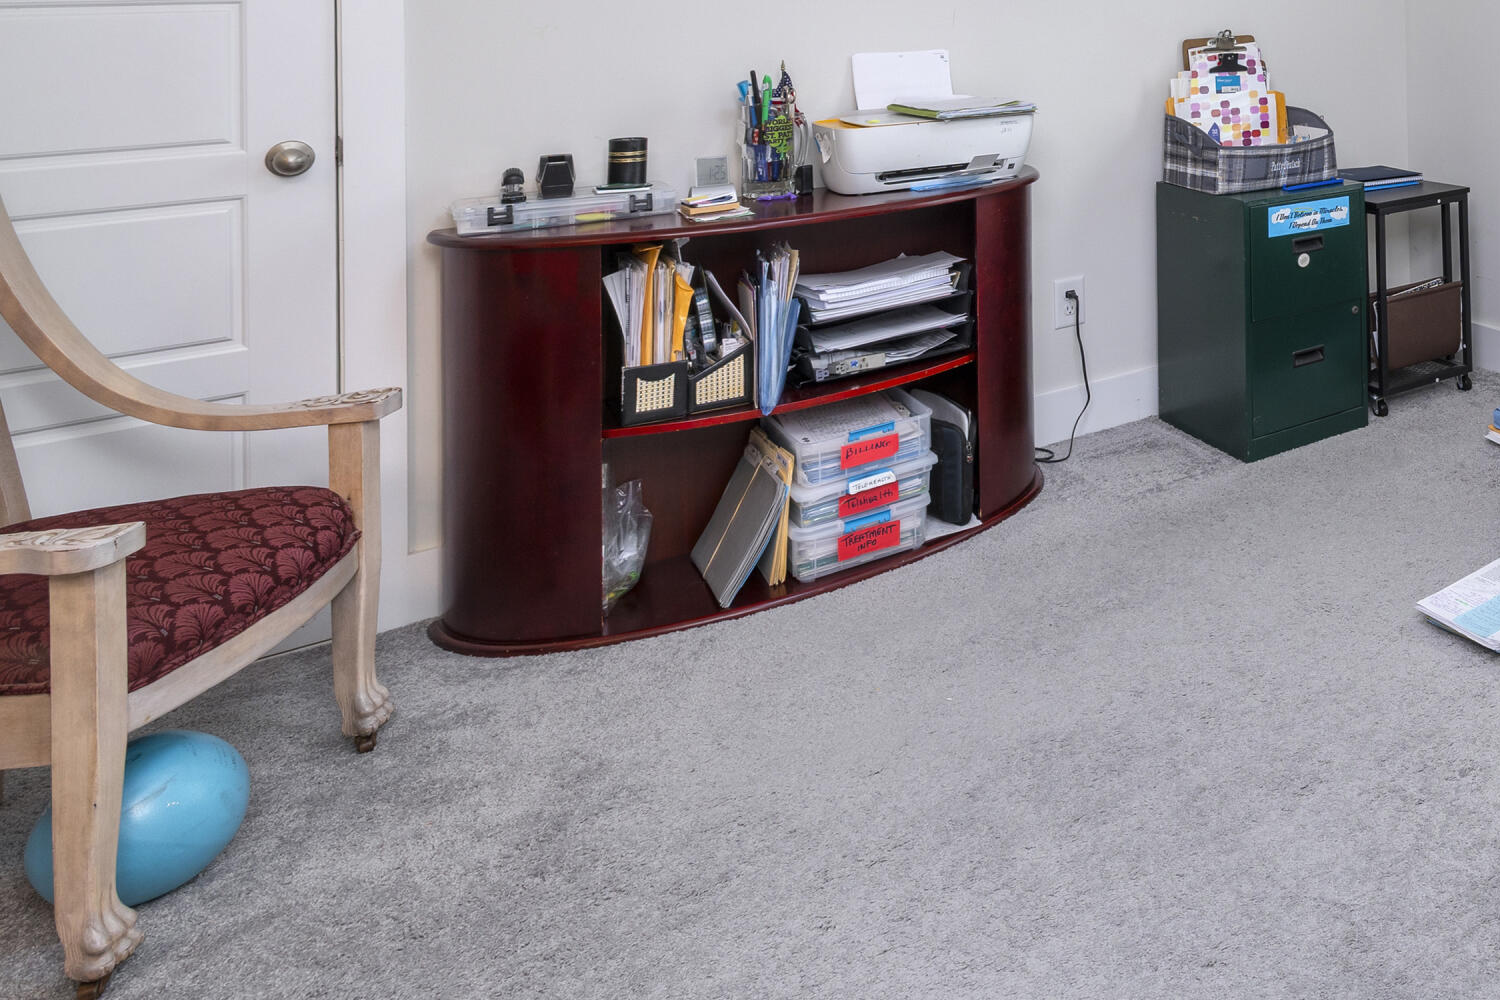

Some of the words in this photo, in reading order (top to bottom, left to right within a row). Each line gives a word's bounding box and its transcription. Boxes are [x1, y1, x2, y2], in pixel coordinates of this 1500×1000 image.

[845, 440, 890, 459] BILLING
[841, 524, 897, 548] TREATMENT
[857, 538, 877, 552] INFO
